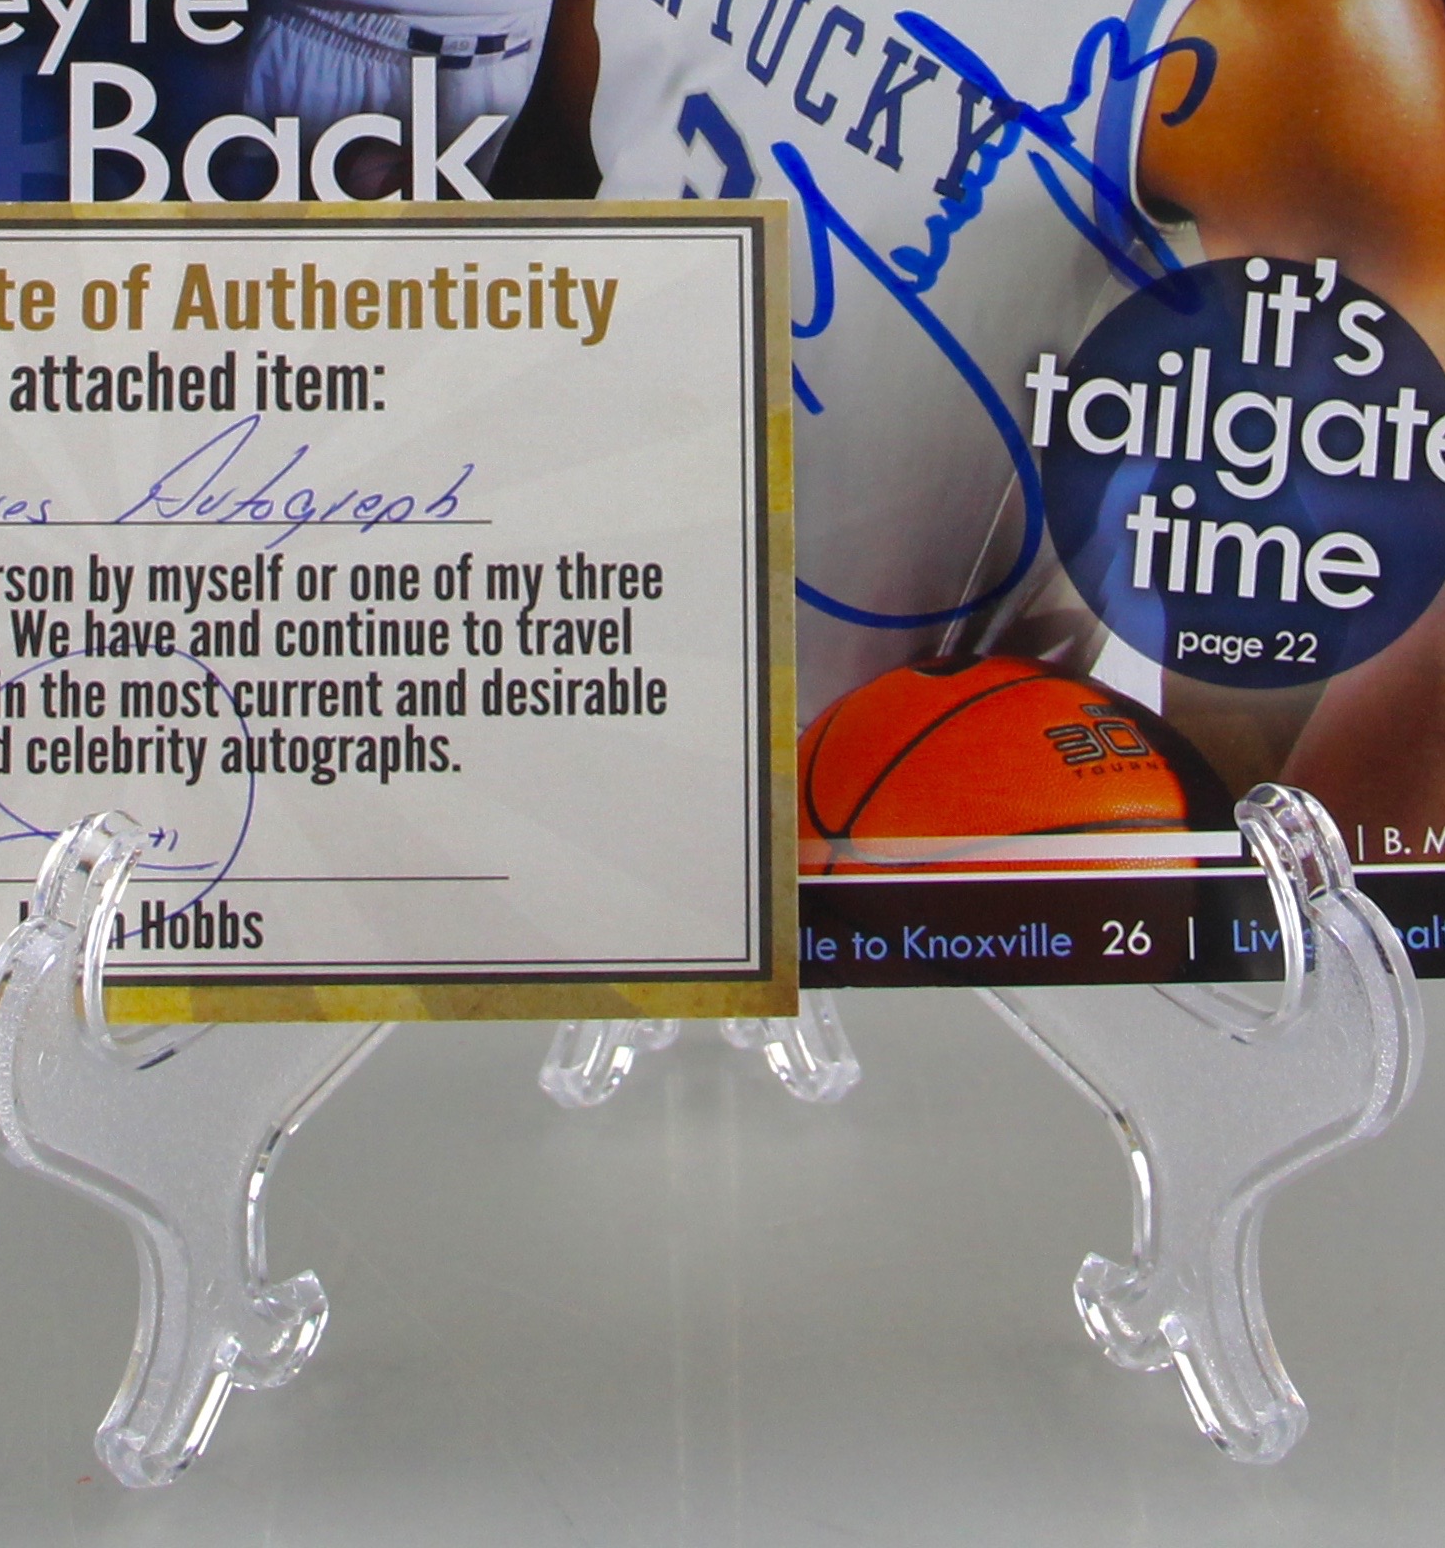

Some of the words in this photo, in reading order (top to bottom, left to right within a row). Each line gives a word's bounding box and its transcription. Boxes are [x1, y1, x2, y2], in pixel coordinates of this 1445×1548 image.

[68, 56, 509, 202] Back
[80, 260, 152, 332] of
[171, 260, 620, 346] Authenticity
[9, 349, 236, 413] attached
[254, 349, 387, 412] item:
[1125, 485, 1383, 610] time
[88, 554, 134, 613] by
[148, 553, 285, 613] myself
[296, 562, 338, 603] or
[353, 561, 421, 602] one
[433, 553, 473, 601] of
[485, 561, 545, 612] my
[556, 552, 664, 601] three
[10, 608, 71, 659] We
[84, 609, 177, 658] have
[190, 609, 262, 658] and
[274, 609, 451, 658] continue
[463, 610, 504, 657] to
[517, 607, 633, 657] travel
[1177, 629, 1264, 665] page
[1274, 631, 1320, 665] 22
[40, 669, 108, 720] the
[120, 671, 221, 719] most
[232, 670, 384, 718] current
[395, 667, 467, 718] and
[481, 666, 669, 717] desirable
[25, 724, 209, 786] celebrity
[220, 723, 463, 786] autographs.
[1382, 826, 1412, 855] B.
[140, 899, 265, 952] Hobbs
[851, 930, 888, 961] to
[902, 922, 1073, 961] Knoxville
[1101, 918, 1153, 958] 26
